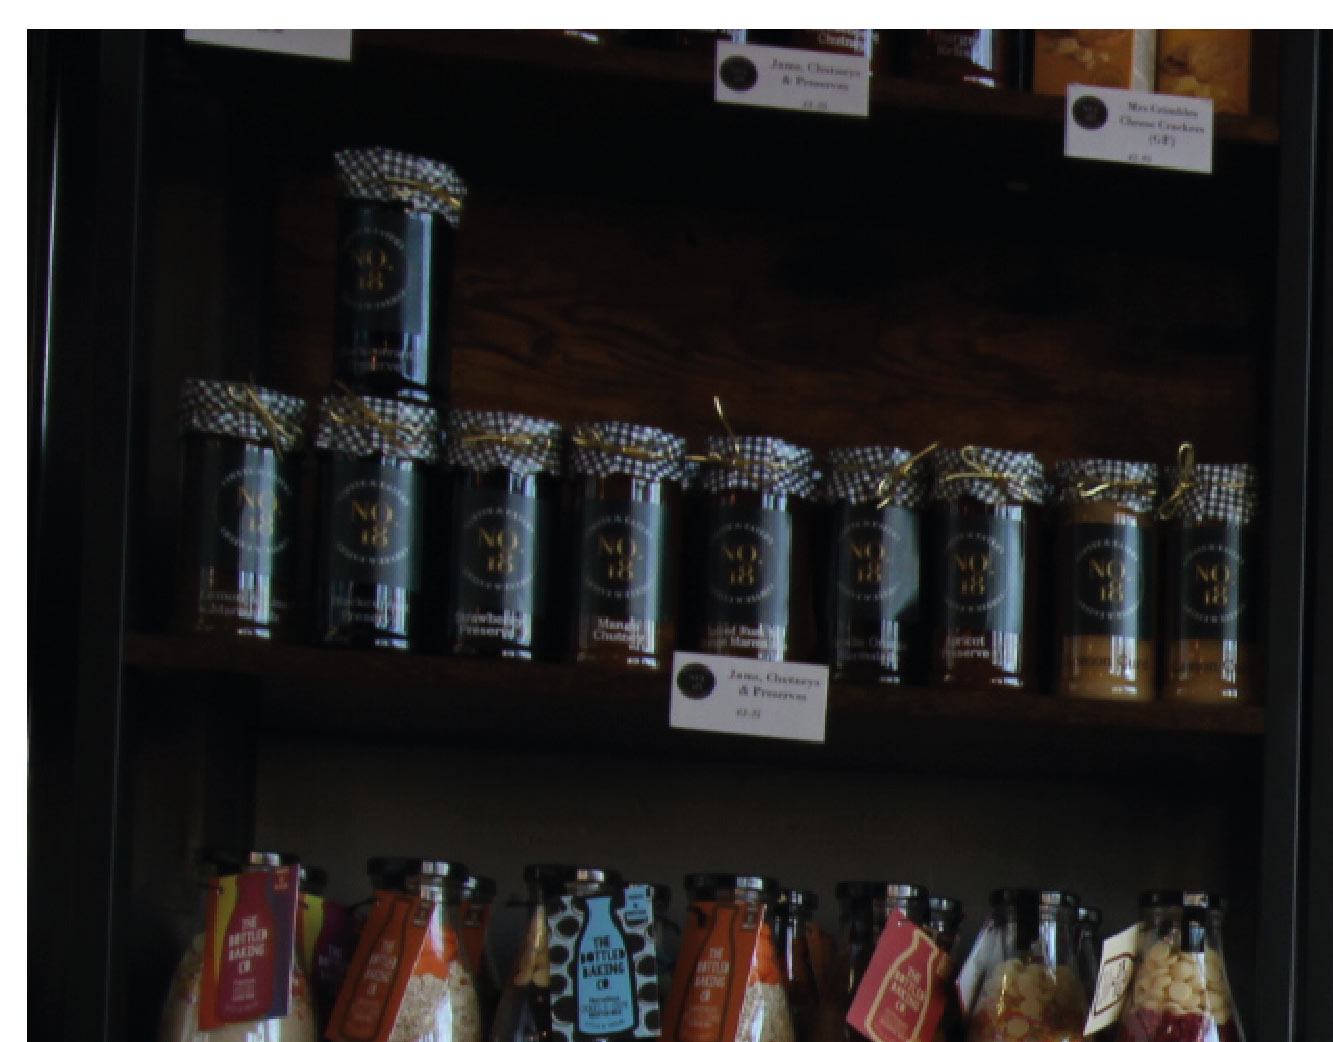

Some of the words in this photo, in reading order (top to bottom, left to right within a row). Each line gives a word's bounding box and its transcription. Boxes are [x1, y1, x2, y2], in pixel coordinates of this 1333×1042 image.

[593, 936, 611, 949] THE
[228, 942, 266, 963] BAKING
[580, 948, 625, 963] BOTTLED
[581, 962, 625, 979] BAKING
